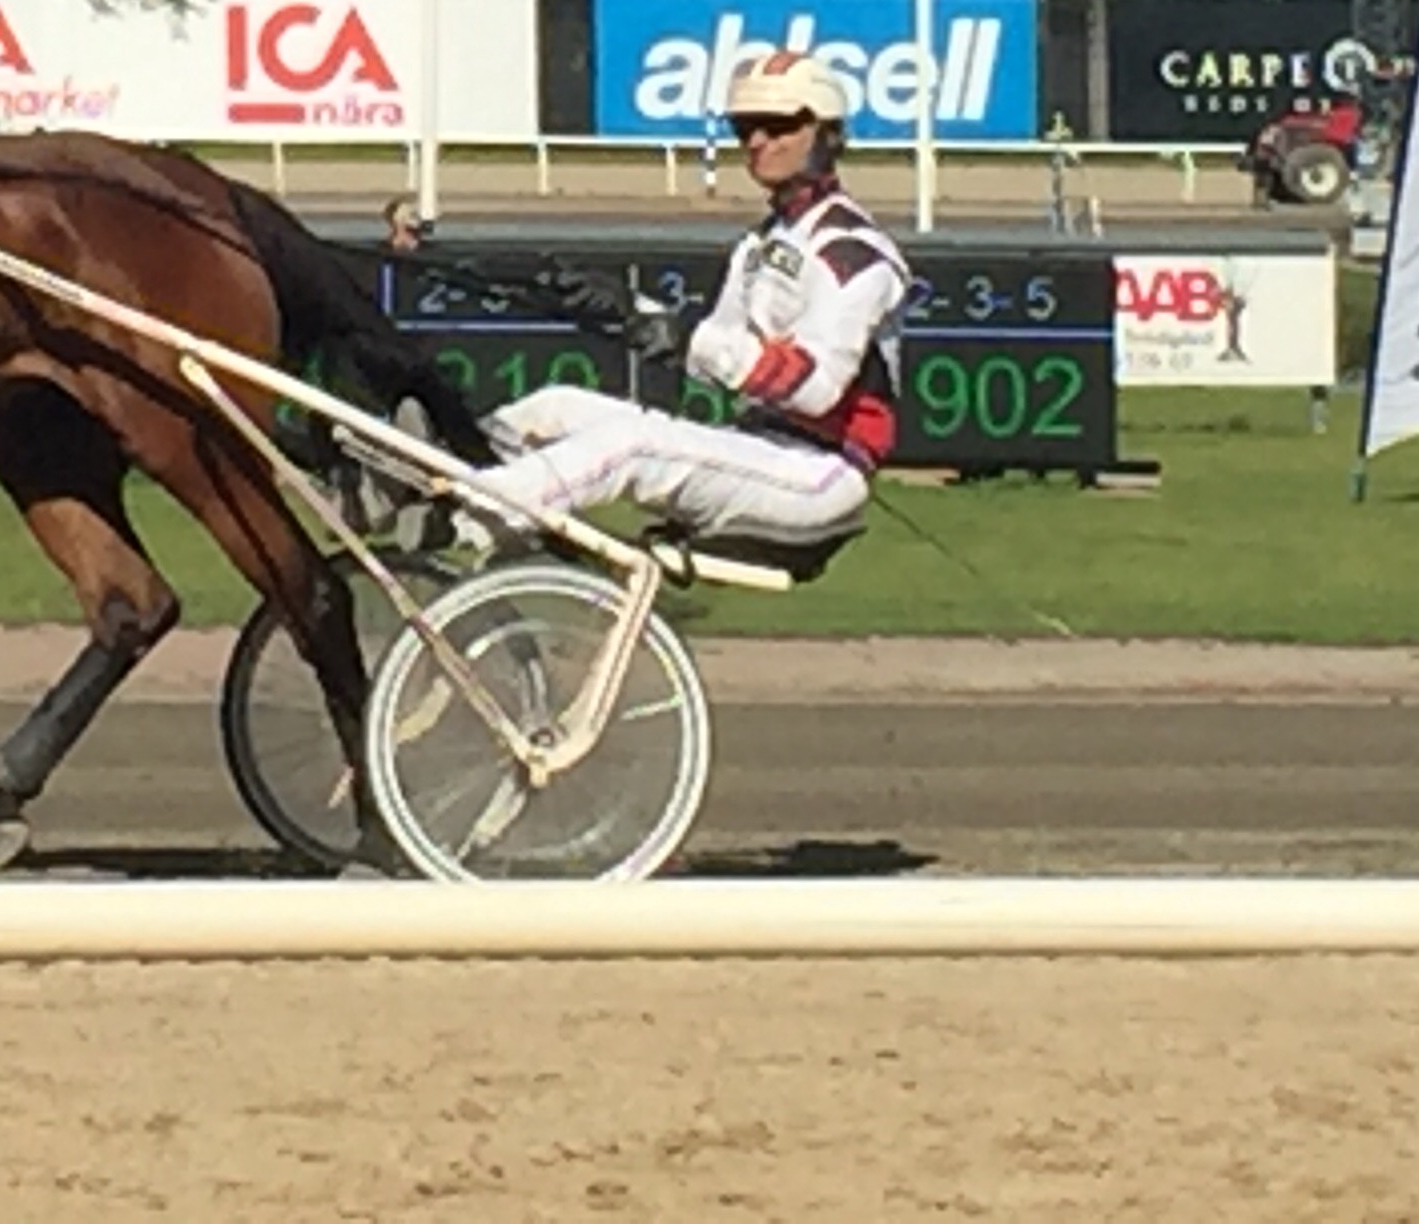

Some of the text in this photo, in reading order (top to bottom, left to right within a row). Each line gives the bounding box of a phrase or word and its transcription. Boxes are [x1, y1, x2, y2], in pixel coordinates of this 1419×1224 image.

[227, 3, 400, 92] ICA
[1160, 49, 1313, 88] CARPE
[914, 354, 1085, 439] 902
